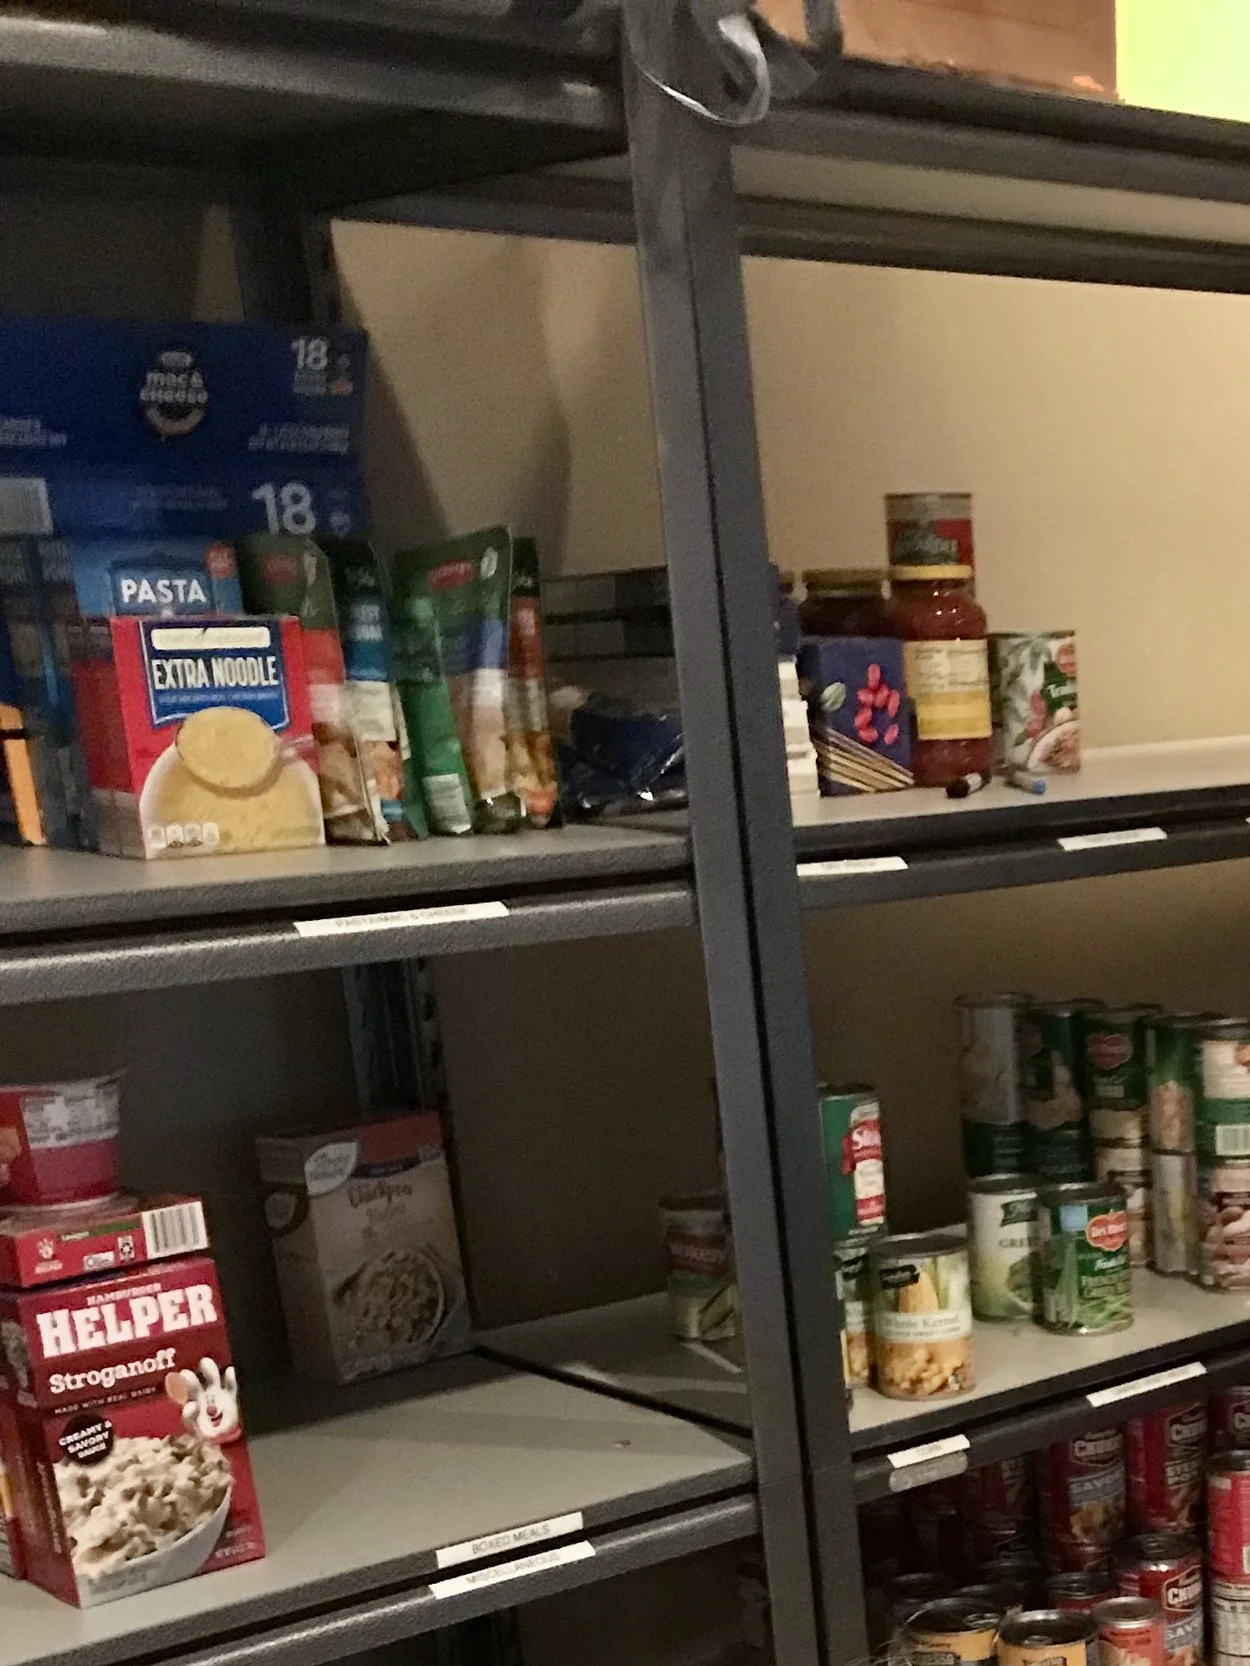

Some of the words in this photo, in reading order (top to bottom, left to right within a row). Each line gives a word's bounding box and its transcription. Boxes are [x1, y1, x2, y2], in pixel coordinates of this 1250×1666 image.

[291, 337, 329, 370] 18
[251, 481, 316, 535] 18
[120, 578, 207, 605] PASTA
[151, 655, 208, 691] EXTRA
[212, 655, 280, 688] NOODLE
[36, 1284, 218, 1358] HELPER
[50, 1348, 176, 1394] Stroganoff
[107, 1393, 129, 1403] REAL
[59, 1423, 103, 1446] CREAMY
[69, 1431, 109, 1454] SAVORY
[472, 1535, 511, 1554] BOXED
[513, 1524, 550, 1542] MEALS
